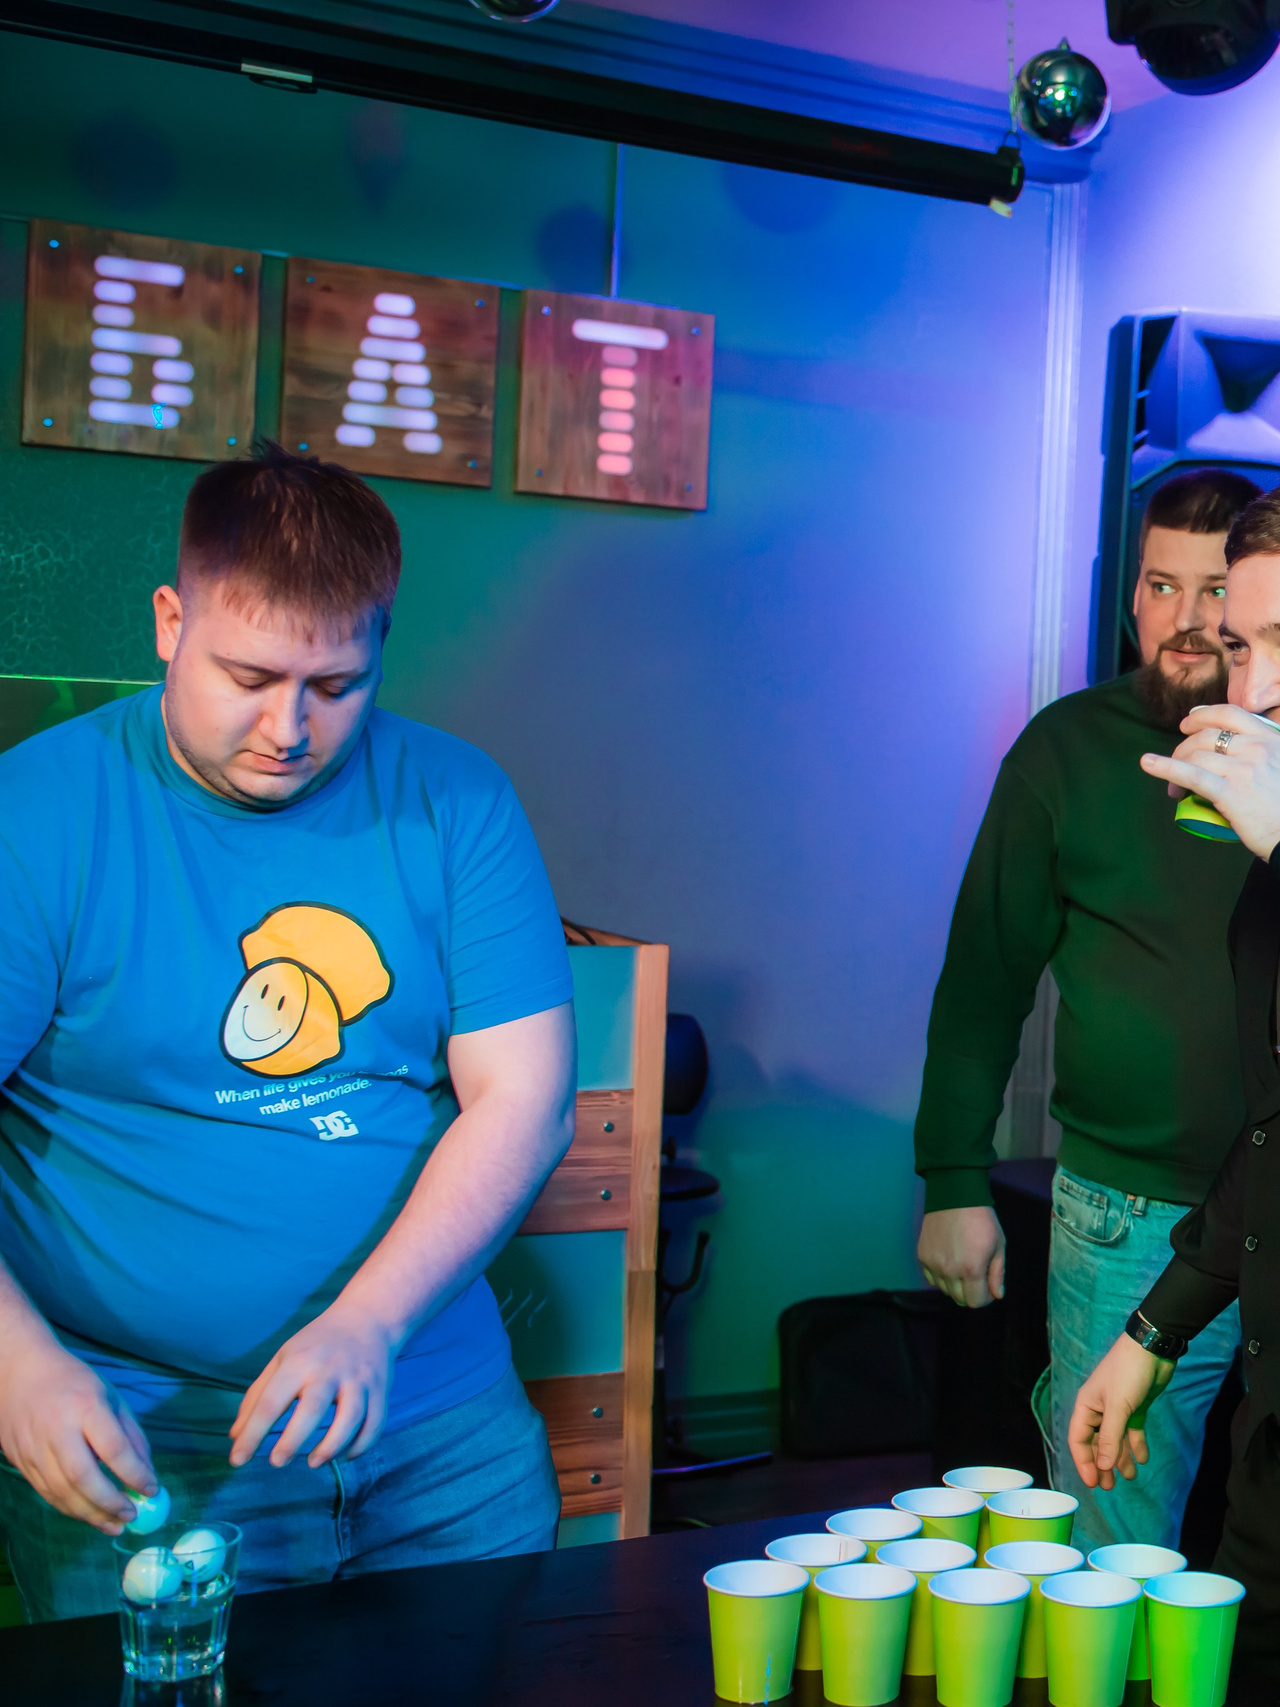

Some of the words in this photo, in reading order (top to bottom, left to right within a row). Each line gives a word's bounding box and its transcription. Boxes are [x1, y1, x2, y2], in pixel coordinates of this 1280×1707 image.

[215, 1088, 260, 1105] When
[263, 1082, 286, 1097] life
[288, 1074, 327, 1093] gives
[259, 1098, 301, 1115] make
[302, 1078, 372, 1107] lemonade.
